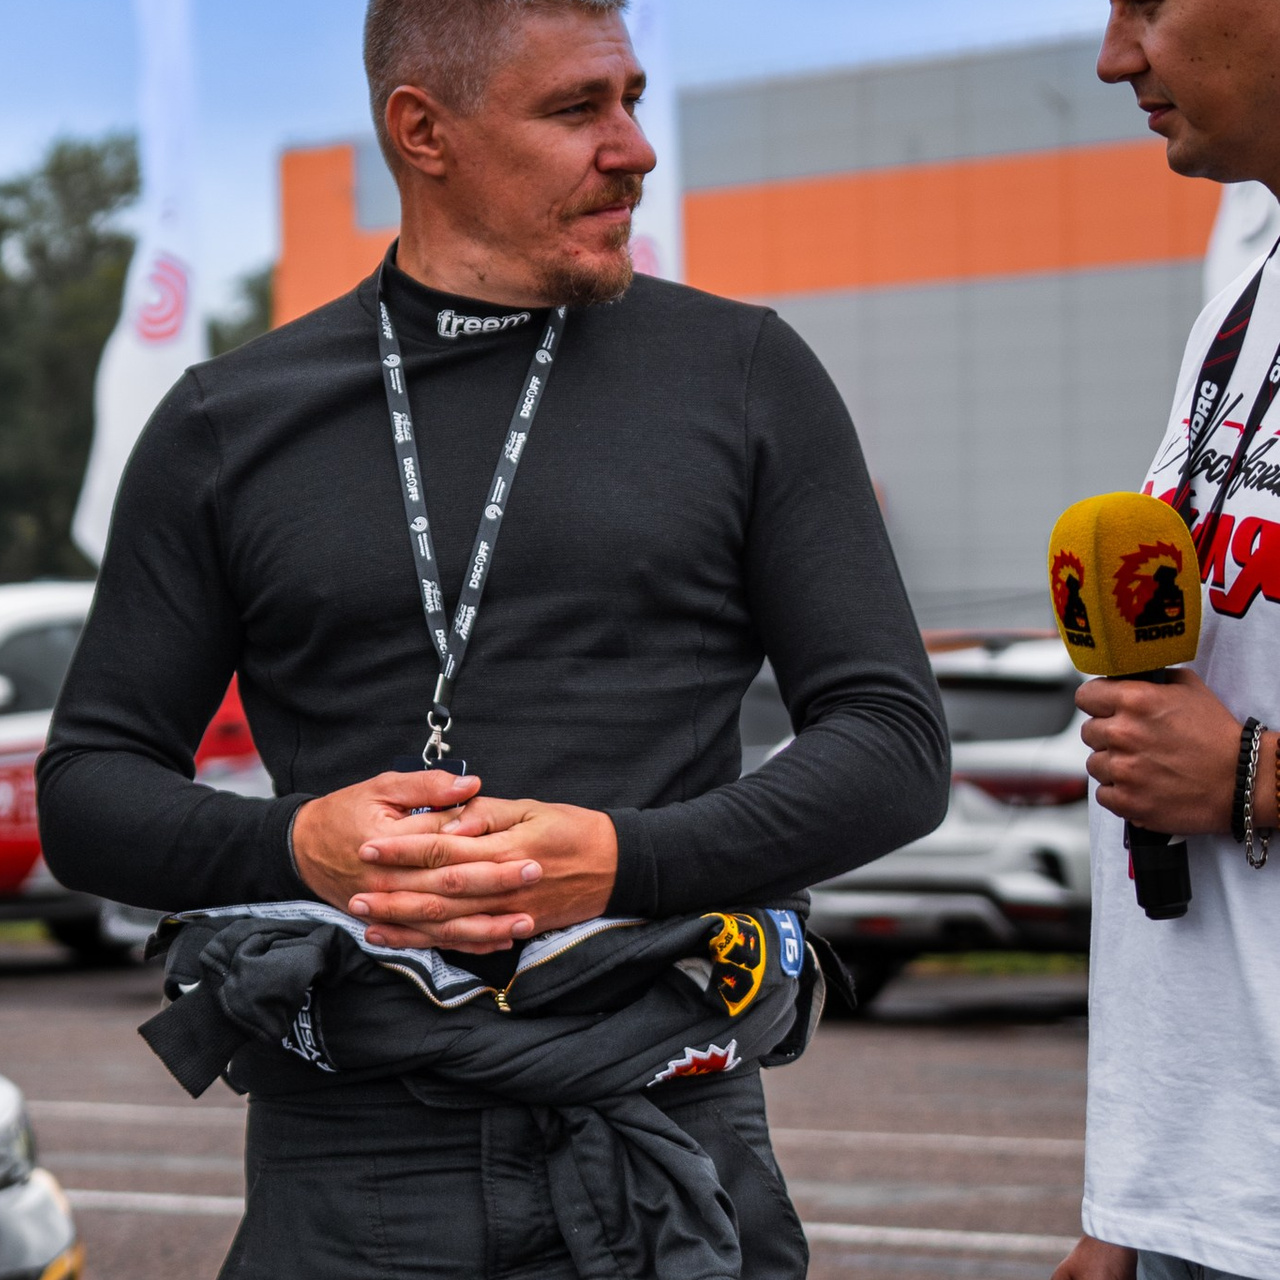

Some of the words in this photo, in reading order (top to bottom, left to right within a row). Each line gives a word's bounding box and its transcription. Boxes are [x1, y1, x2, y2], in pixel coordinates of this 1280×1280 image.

[437, 309, 531, 338] freem
[520, 375, 541, 418] DSCOFF
[403, 457, 420, 502] DSCOFF
[469, 540, 491, 590] DSCOFF
